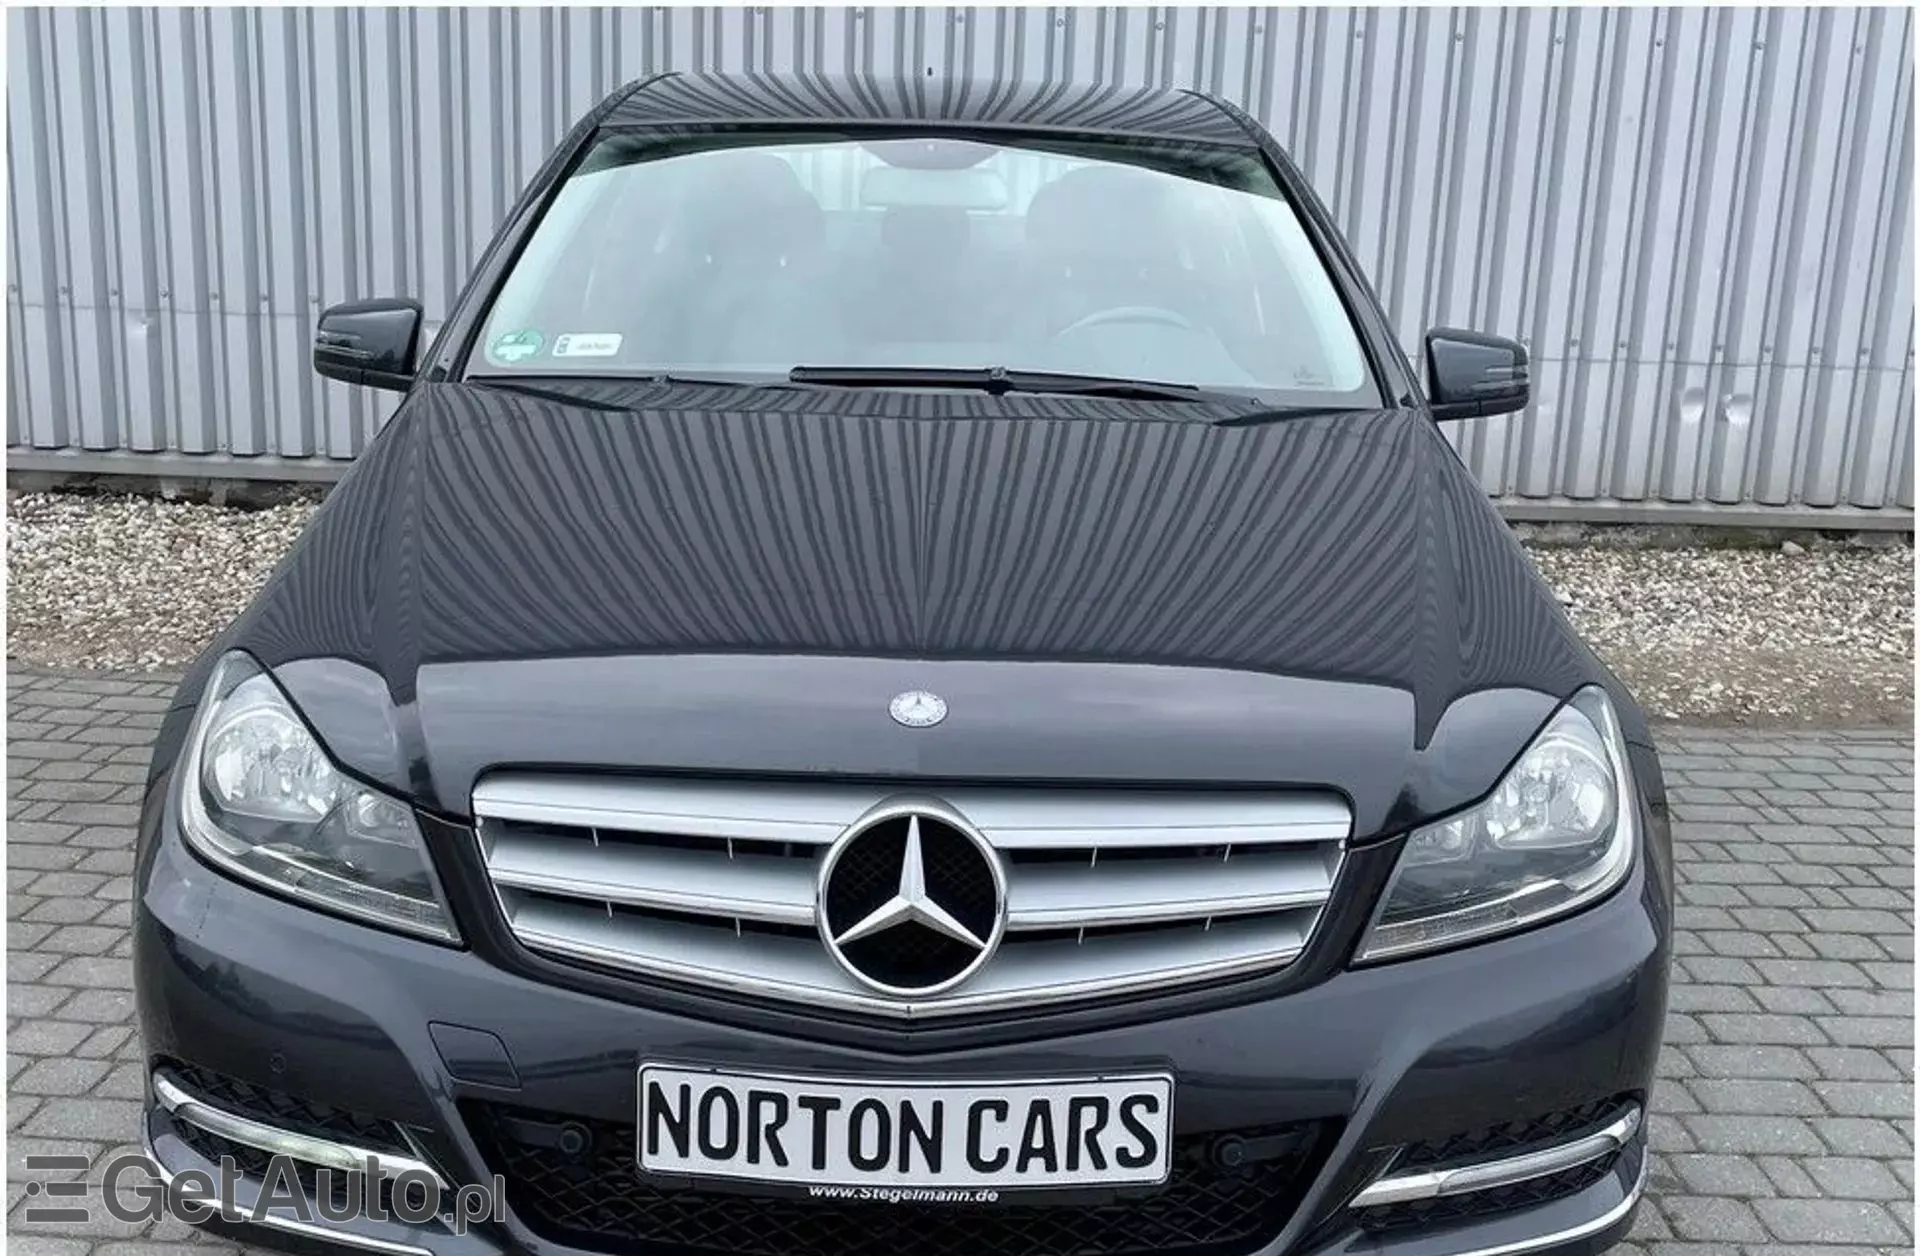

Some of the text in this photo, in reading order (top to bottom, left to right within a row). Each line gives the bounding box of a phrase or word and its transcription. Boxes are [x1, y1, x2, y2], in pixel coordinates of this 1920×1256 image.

[647, 1080, 1159, 1174] NORTON CARS
[808, 1185, 999, 1204] www.Stegelmann.de
